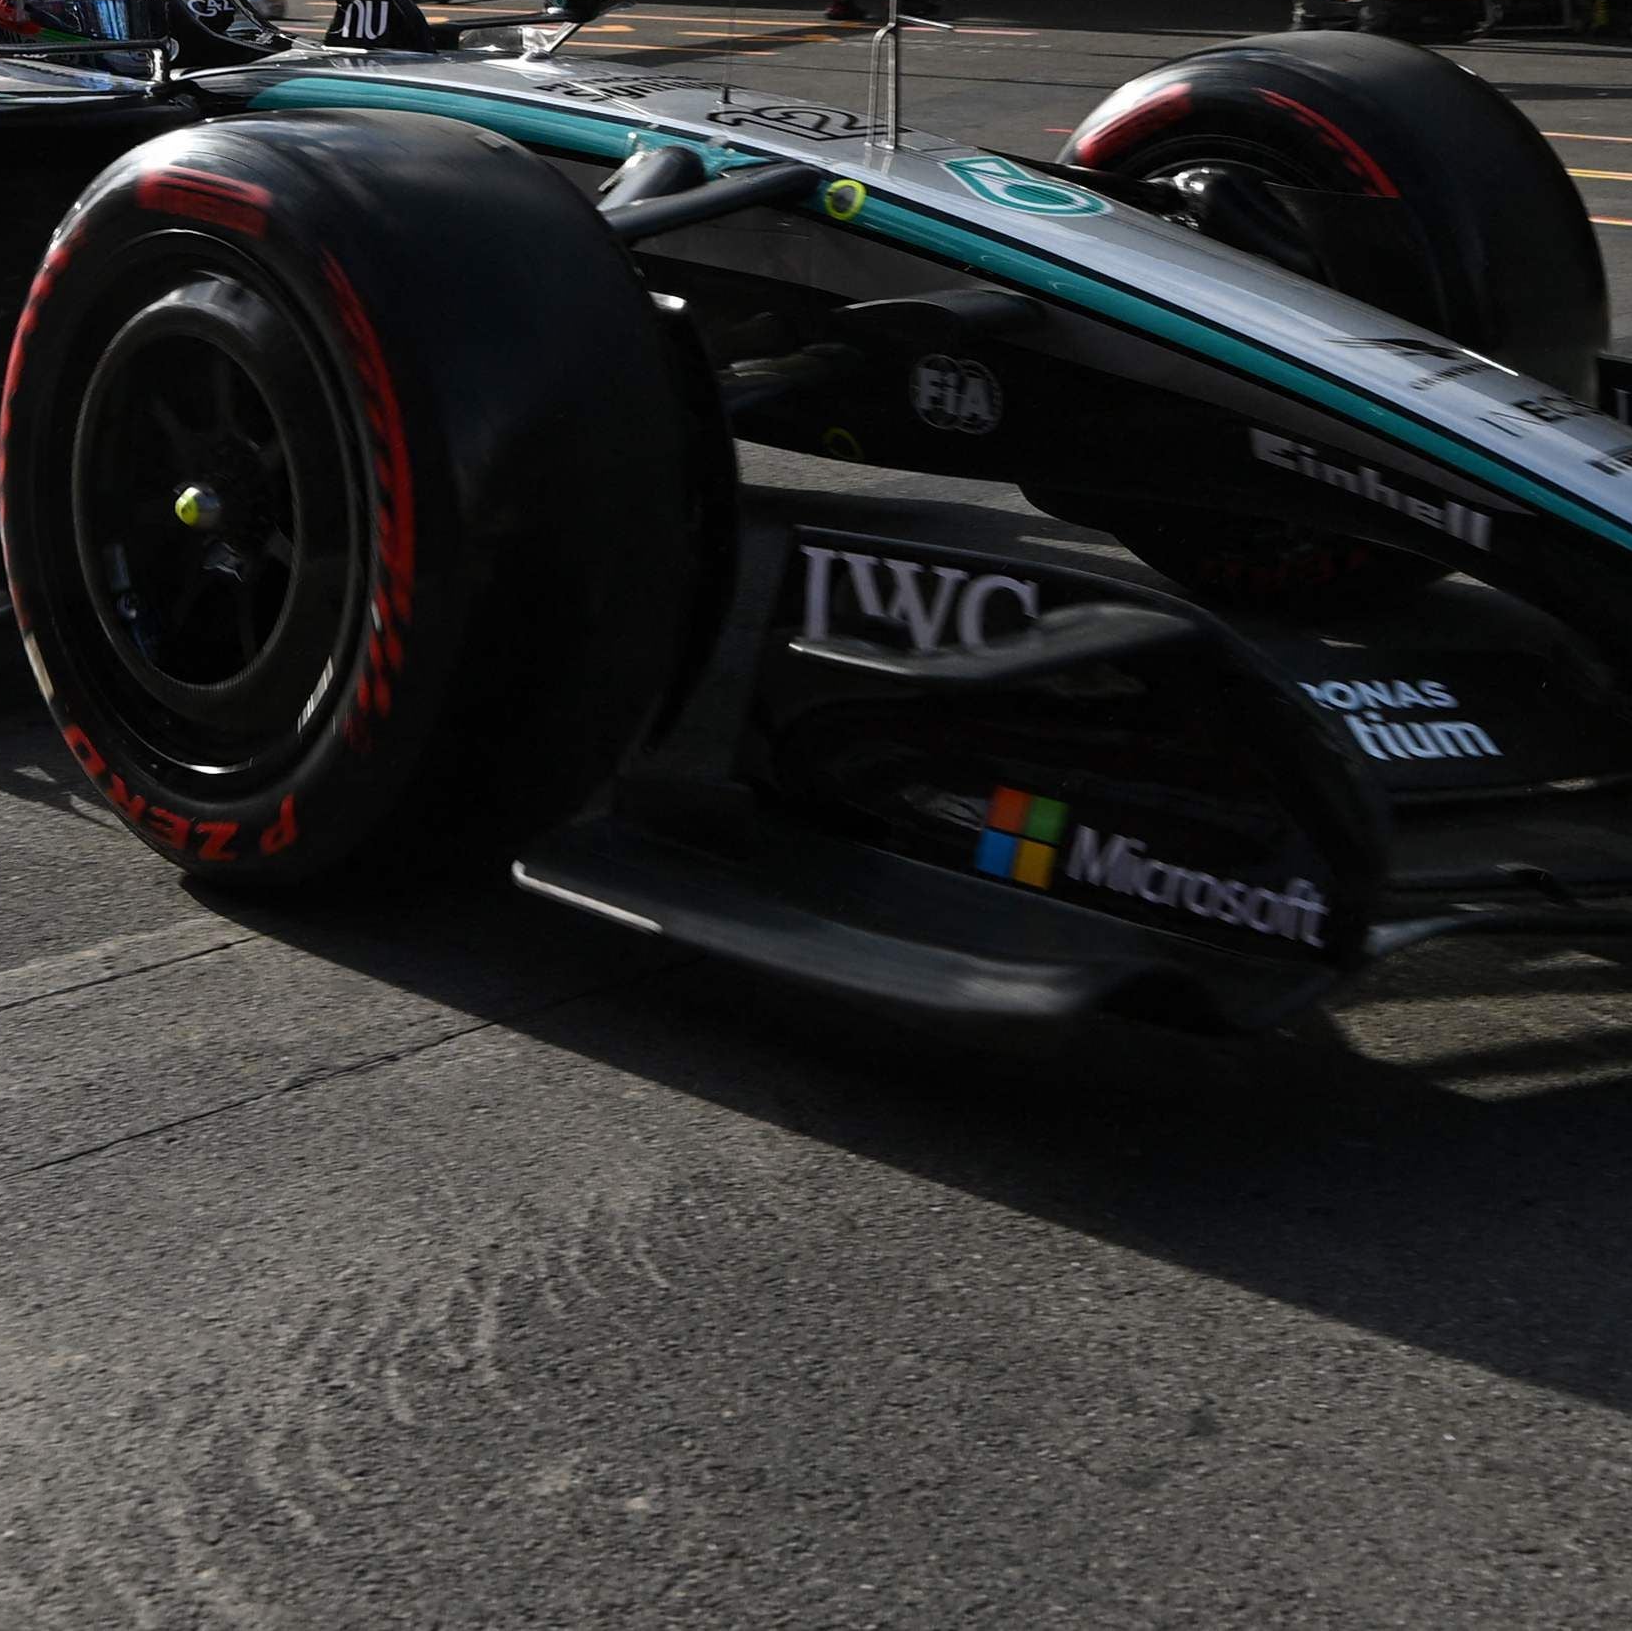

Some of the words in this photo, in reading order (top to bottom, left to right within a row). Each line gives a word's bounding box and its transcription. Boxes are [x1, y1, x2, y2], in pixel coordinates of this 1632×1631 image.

[1249, 426, 1495, 552] Einhell
[799, 544, 1042, 654] IWC
[1067, 826, 1331, 951] Microsoft
